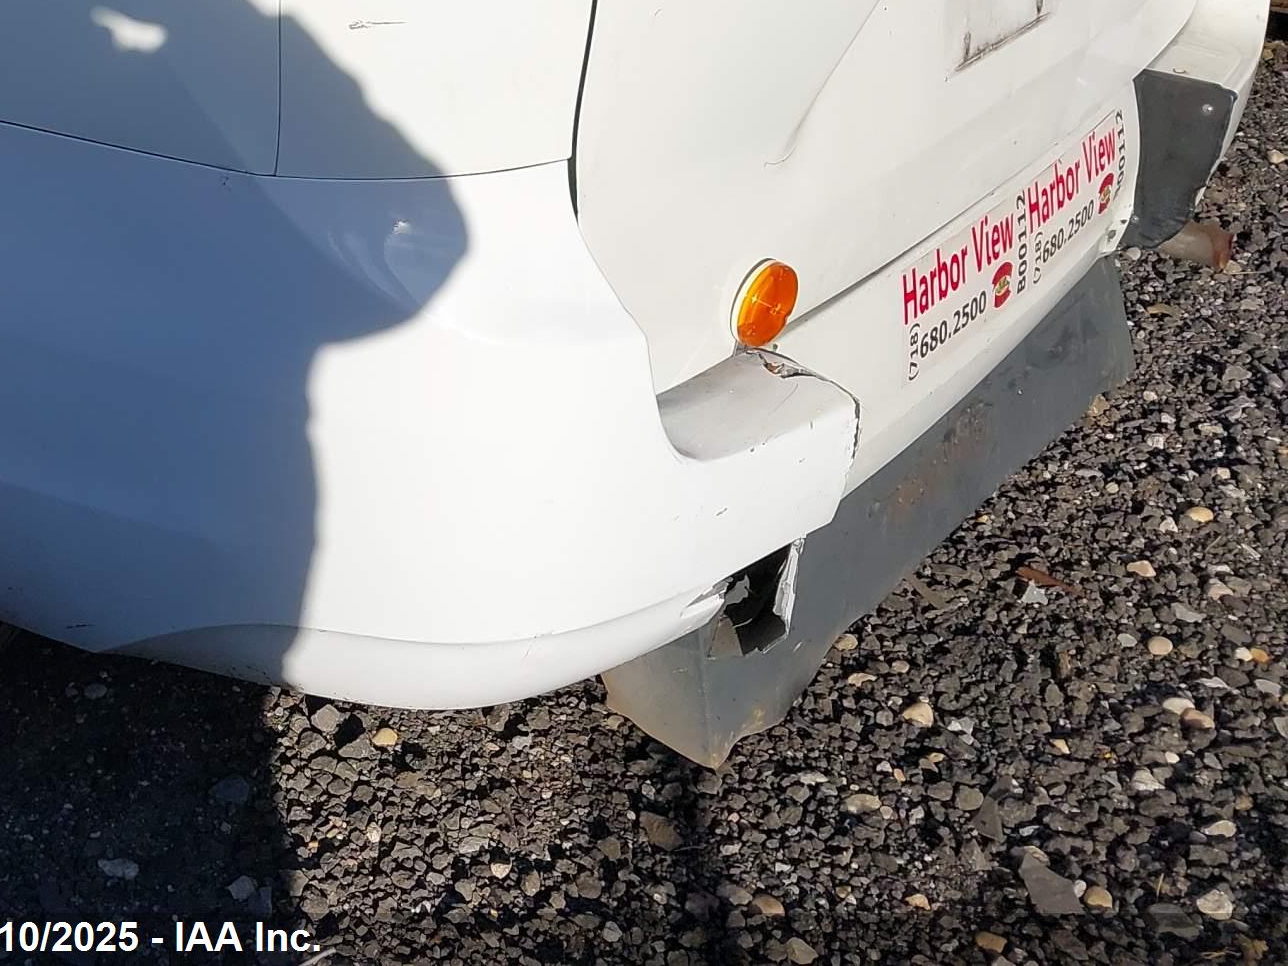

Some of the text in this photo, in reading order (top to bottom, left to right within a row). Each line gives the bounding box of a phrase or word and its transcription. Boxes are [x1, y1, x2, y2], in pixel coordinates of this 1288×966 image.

[1027, 128, 1117, 234] Harbor View
[902, 212, 1014, 326] Harbor View
[1016, 189, 1028, 295] B00112
[1042, 199, 1095, 264] 680.2500
[908, 322, 921, 382] (718)
[919, 290, 987, 359] 680.2500
